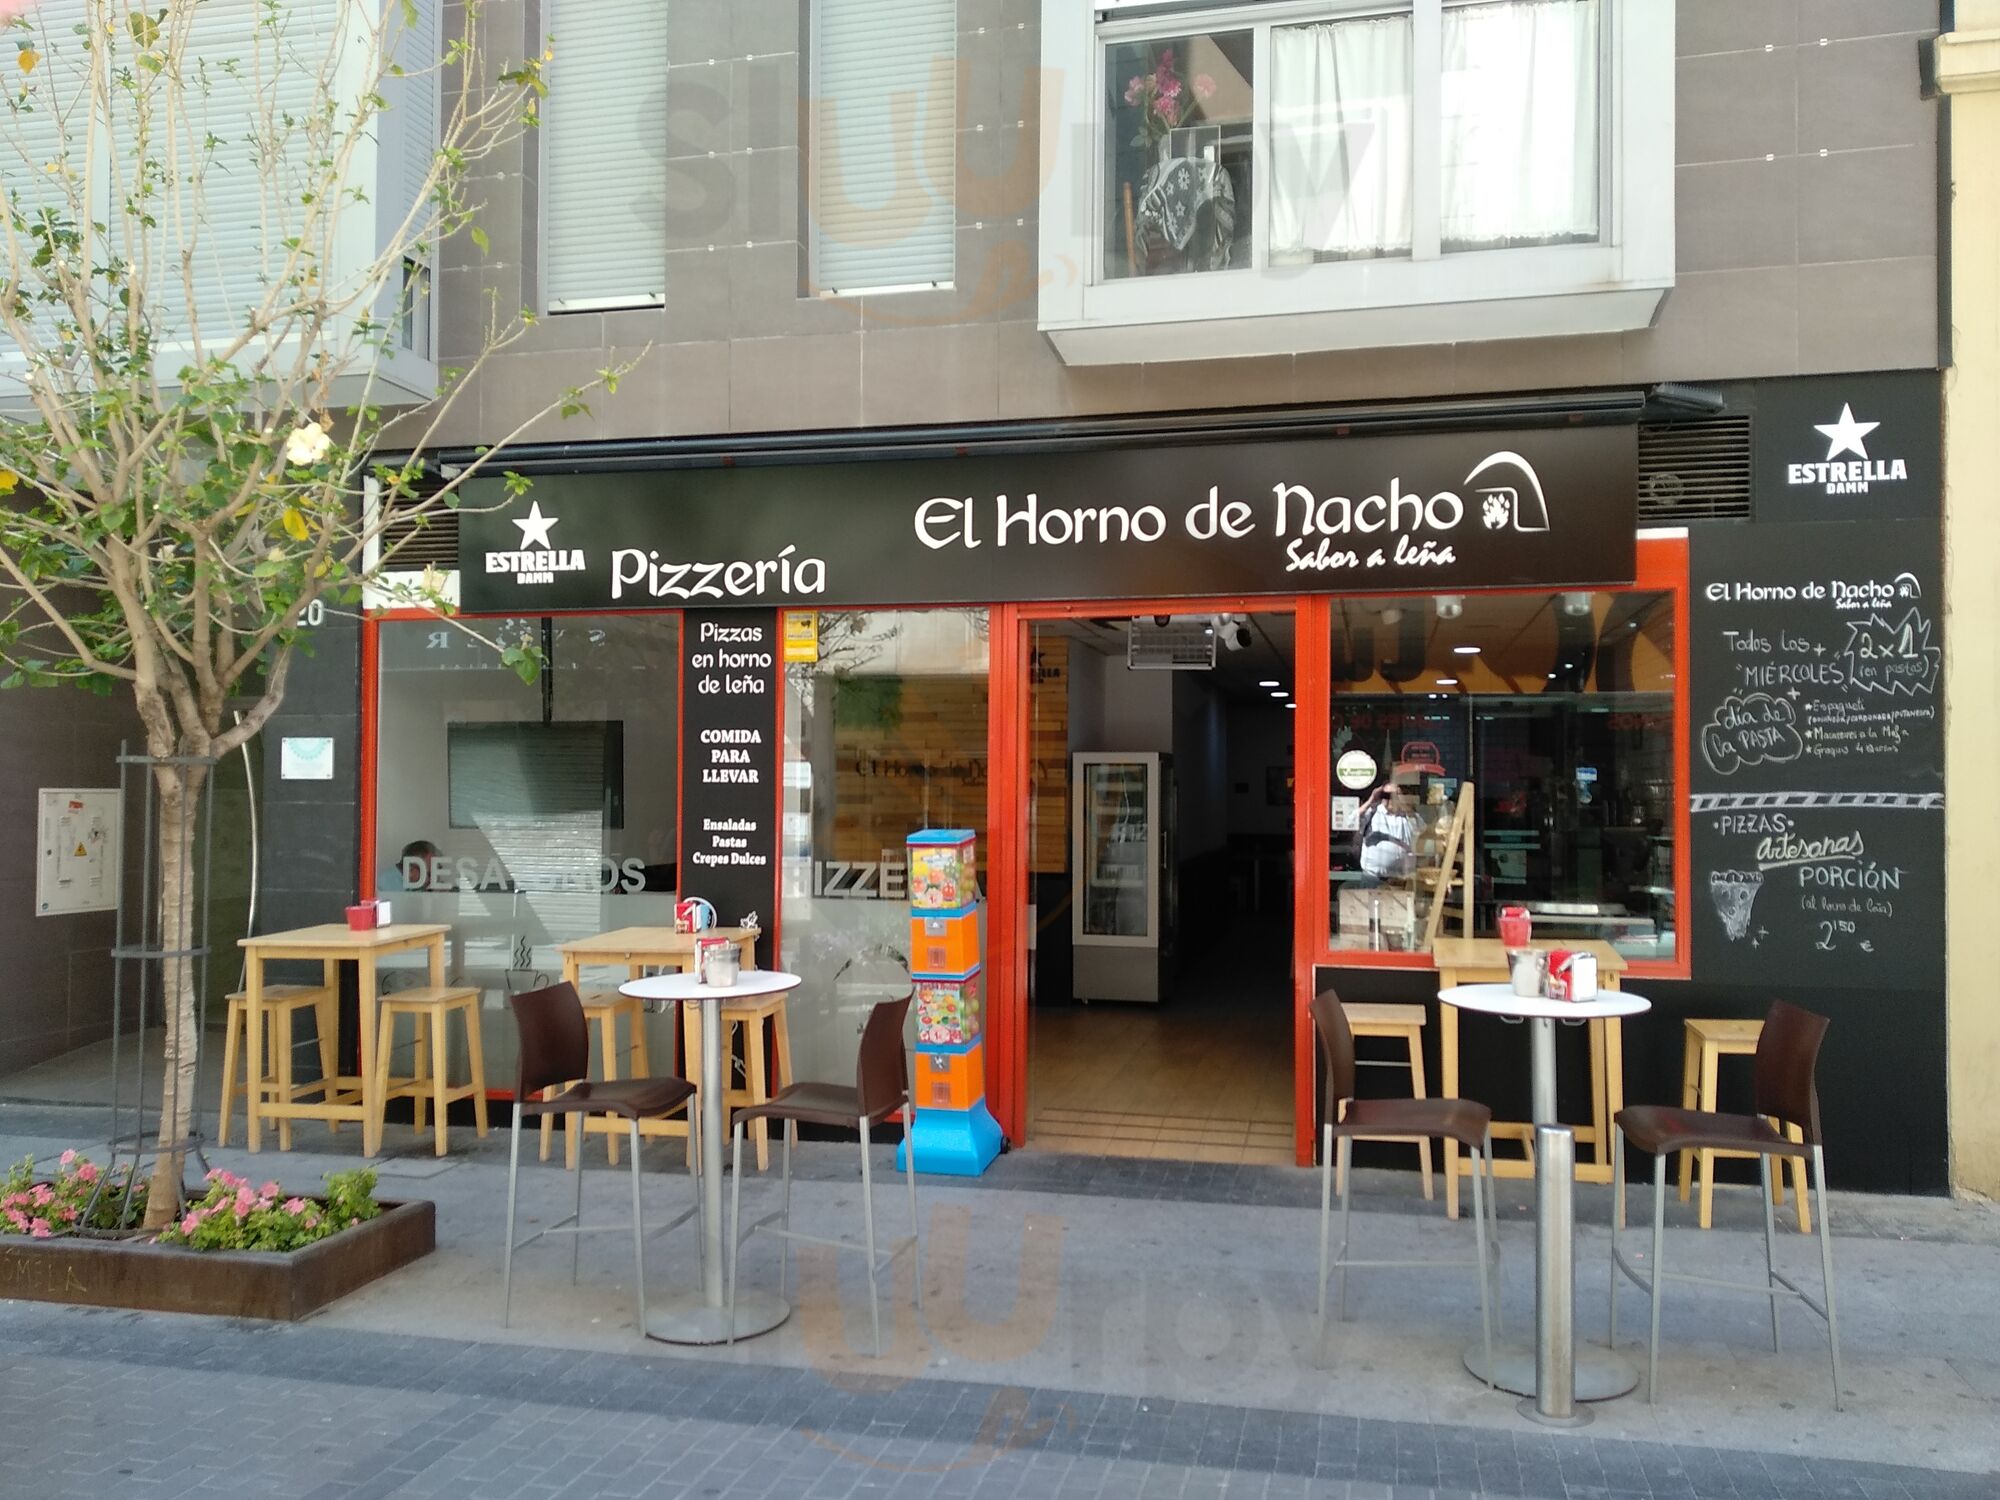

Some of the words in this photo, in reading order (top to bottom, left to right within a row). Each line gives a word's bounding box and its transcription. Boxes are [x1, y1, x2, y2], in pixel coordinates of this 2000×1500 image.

[1787, 459, 1908, 484] ESTRELLA
[1826, 482, 1869, 495] DAMM
[914, 496, 981, 550] El
[996, 492, 1168, 547] Horno
[1185, 485, 1256, 540] de
[1272, 476, 1465, 537] Nacho
[485, 549, 586, 574] ESTRELLA
[1285, 537, 1359, 573] Sabor
[1366, 547, 1387, 567] a
[1395, 535, 1457, 567] leña
[516, 572, 555, 585] DAMM
[611, 543, 827, 600] Pizzería
[1705, 582, 1729, 601] El
[1736, 581, 1797, 601] Horno
[1801, 581, 1827, 600] de
[1831, 579, 1895, 600] Nacho
[1862, 601, 1870, 609] a
[699, 621, 764, 644] Pizzas
[1722, 628, 1772, 652] Todos
[692, 652, 716, 669] en
[719, 648, 772, 669] horno
[697, 675, 721, 695] de
[726, 674, 765, 695] leña
[1763, 703, 1787, 723] de
[699, 729, 762, 745] COMIDA
[1738, 725, 1786, 751] PASTA
[710, 749, 751, 764] PARA
[701, 769, 759, 784] LLEVAR
[702, 818, 757, 833] Ensaladas
[711, 835, 748, 849] Pastas
[692, 852, 729, 867] Crepes
[730, 851, 767, 867] Dulces
